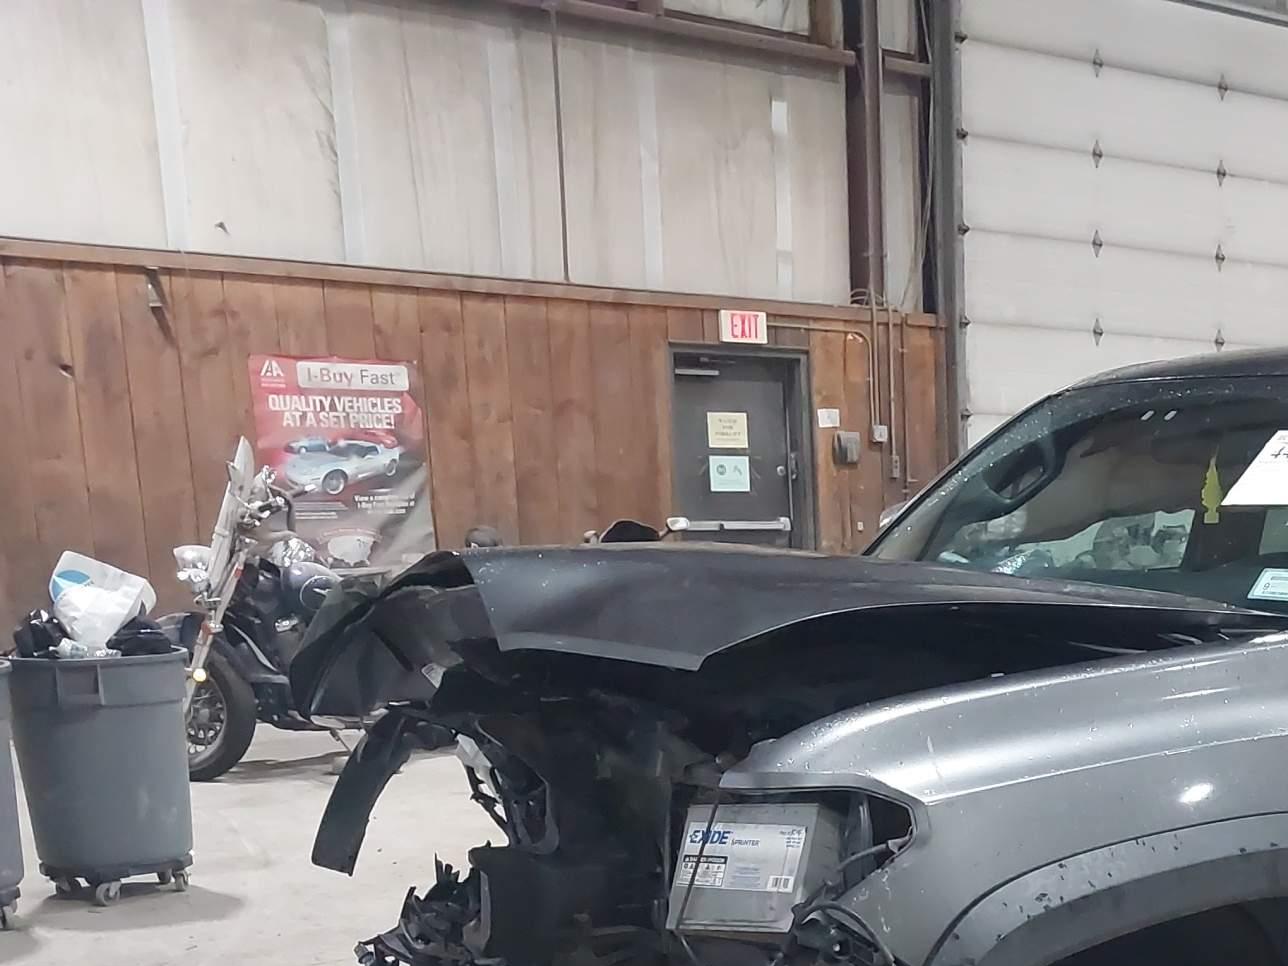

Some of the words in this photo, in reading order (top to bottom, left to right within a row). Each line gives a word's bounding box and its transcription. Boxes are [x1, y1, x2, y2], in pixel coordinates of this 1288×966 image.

[730, 313, 760, 339] EXIT
[307, 367, 353, 387] I-Buy
[359, 369, 396, 385] Fast
[268, 394, 334, 412] QUALITY
[333, 395, 402, 414] VEHICLES
[282, 412, 302, 428] AT
[304, 413, 319, 428] A
[318, 413, 347, 429] SET
[350, 413, 396, 430] PRICE!
